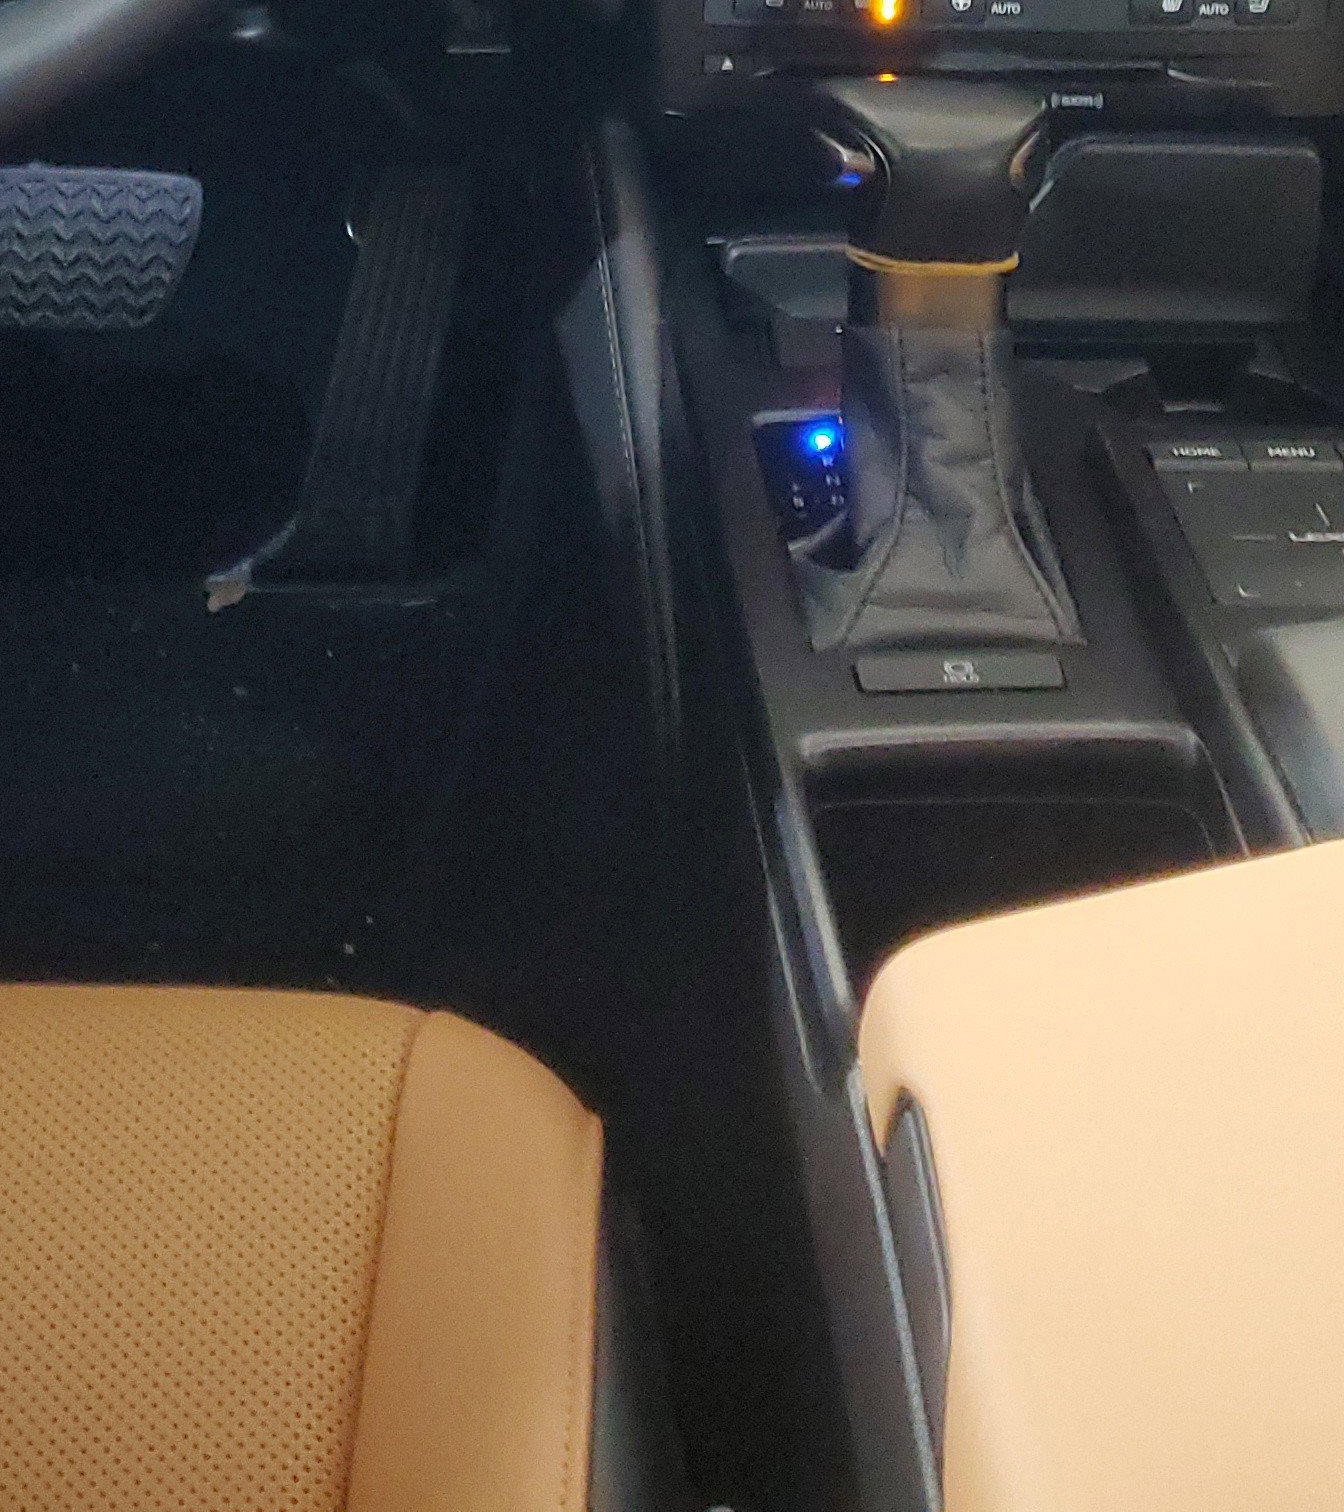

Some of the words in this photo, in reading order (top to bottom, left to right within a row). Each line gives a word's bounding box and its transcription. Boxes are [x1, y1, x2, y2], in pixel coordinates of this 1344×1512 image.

[990, 2, 1022, 16] AUTO
[1198, 3, 1230, 17] AUTO
[1266, 446, 1316, 459] MENU
